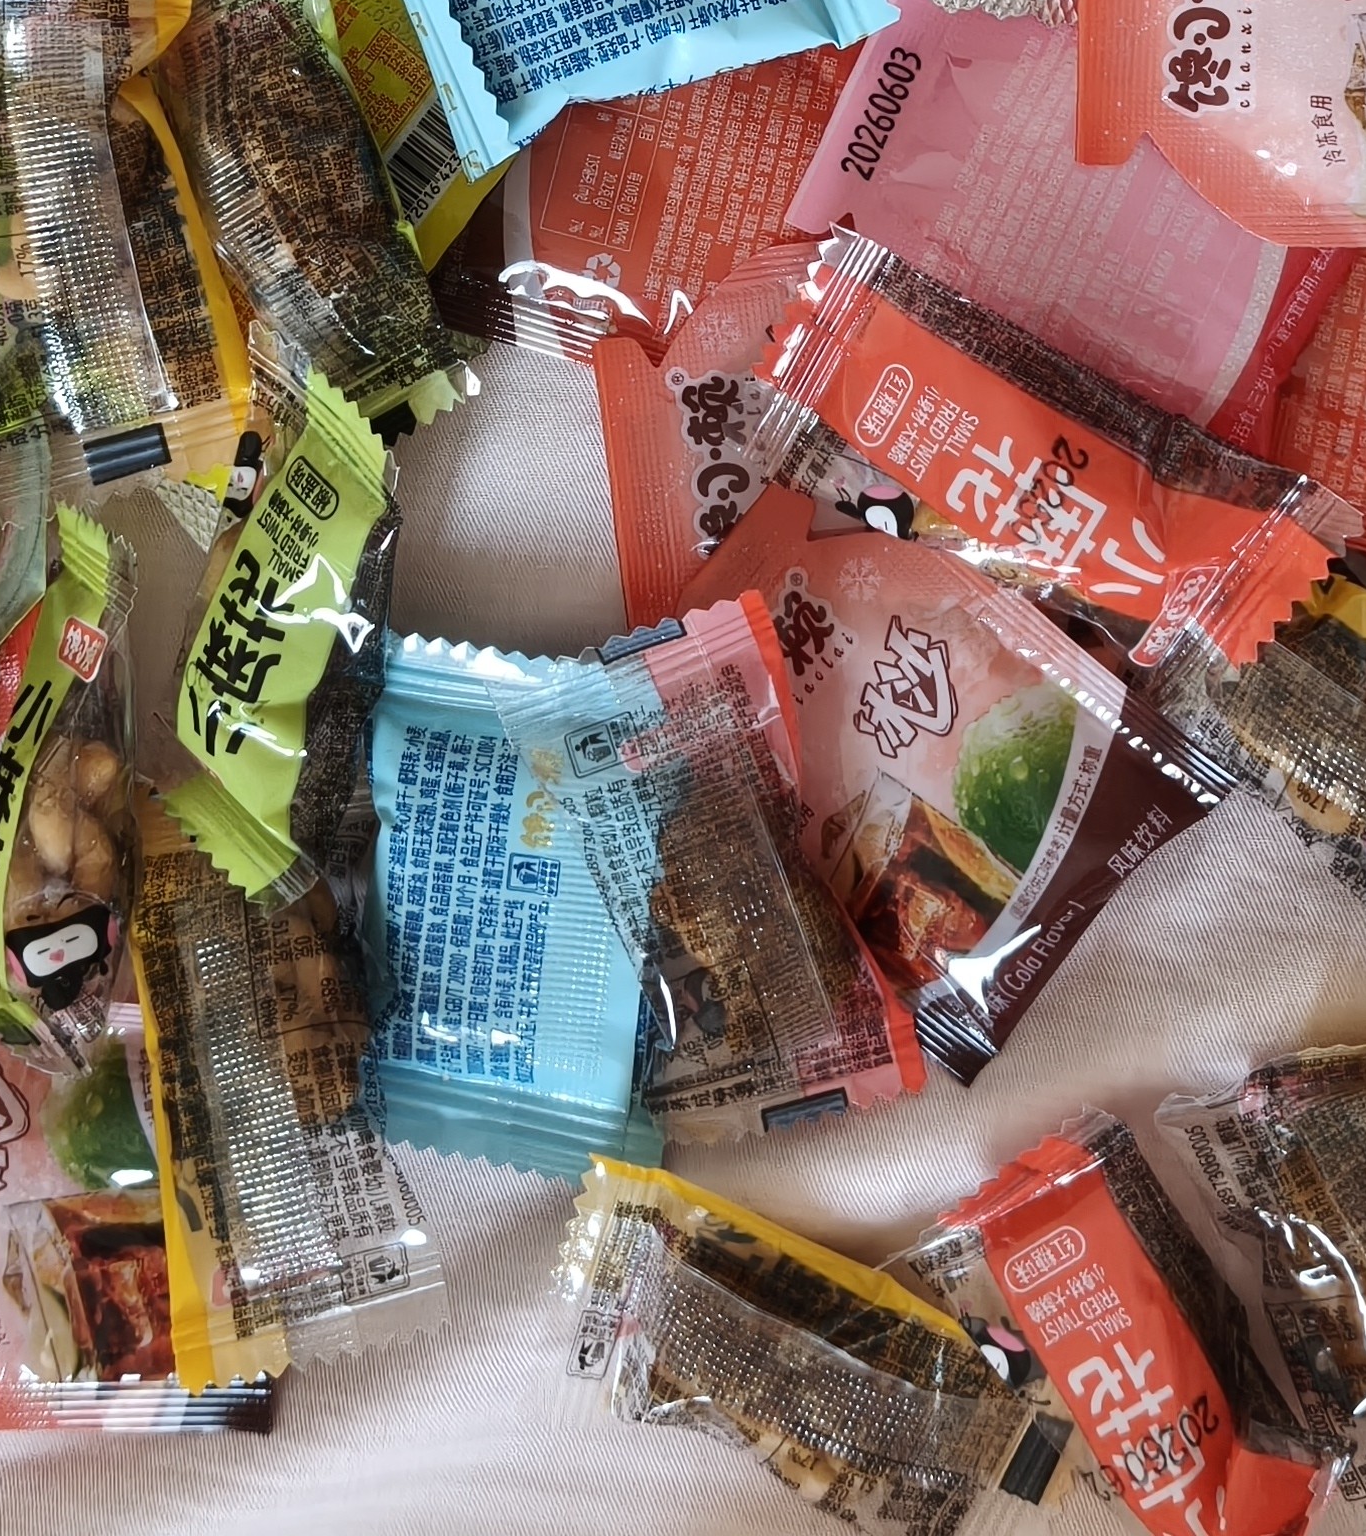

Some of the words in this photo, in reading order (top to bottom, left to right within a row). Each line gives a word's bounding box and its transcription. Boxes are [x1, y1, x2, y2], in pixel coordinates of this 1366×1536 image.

[836, 40, 926, 184] 20260603
[1311, 94, 1346, 166] 冷冻食用
[856, 362, 913, 442] 红糖味
[922, 393, 962, 444] FRIED
[901, 434, 942, 484] TWIST
[938, 403, 983, 462] SMALL
[281, 457, 339, 515] 椒盐味
[944, 429, 1167, 596] 小麻花
[250, 505, 290, 545] TWIST
[182, 547, 306, 757] 小麻花
[1103, 802, 1176, 879] 风味饮料
[1006, 1227, 1080, 1292] 红糖味
[1034, 1303, 1086, 1349] TWIST
[1074, 1282, 1123, 1325] FRIED
[1083, 1302, 1135, 1349] SMALL
